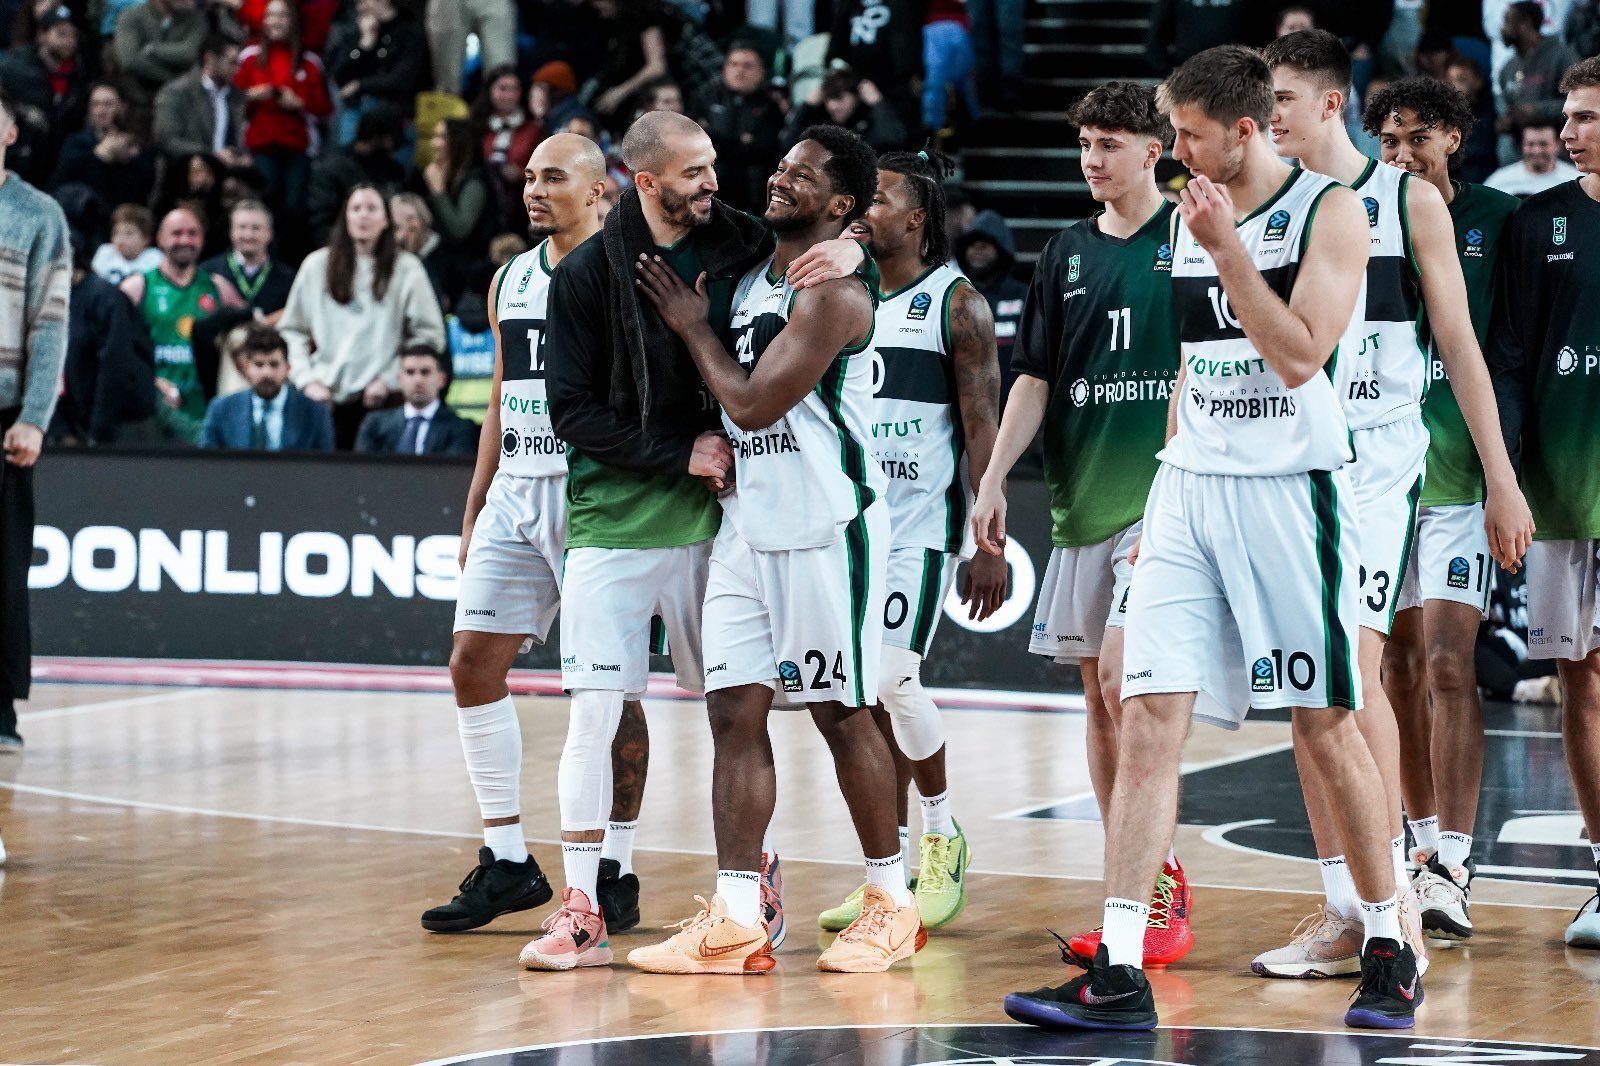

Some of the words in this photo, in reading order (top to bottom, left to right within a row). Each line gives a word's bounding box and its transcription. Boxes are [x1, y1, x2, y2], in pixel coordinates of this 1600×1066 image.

[1547, 252, 1574, 263] SPALDING
[1107, 307, 1131, 352] 11
[1209, 395, 1296, 419] PROBITAS
[464, 609, 496, 617] SPALDING
[884, 591, 909, 630] 0
[1056, 634, 1085, 643] SPALDING
[1529, 627, 1544, 637] vdf
[591, 663, 621, 672] SPALDING
[804, 649, 847, 690] 24
[1271, 648, 1316, 692] 10
